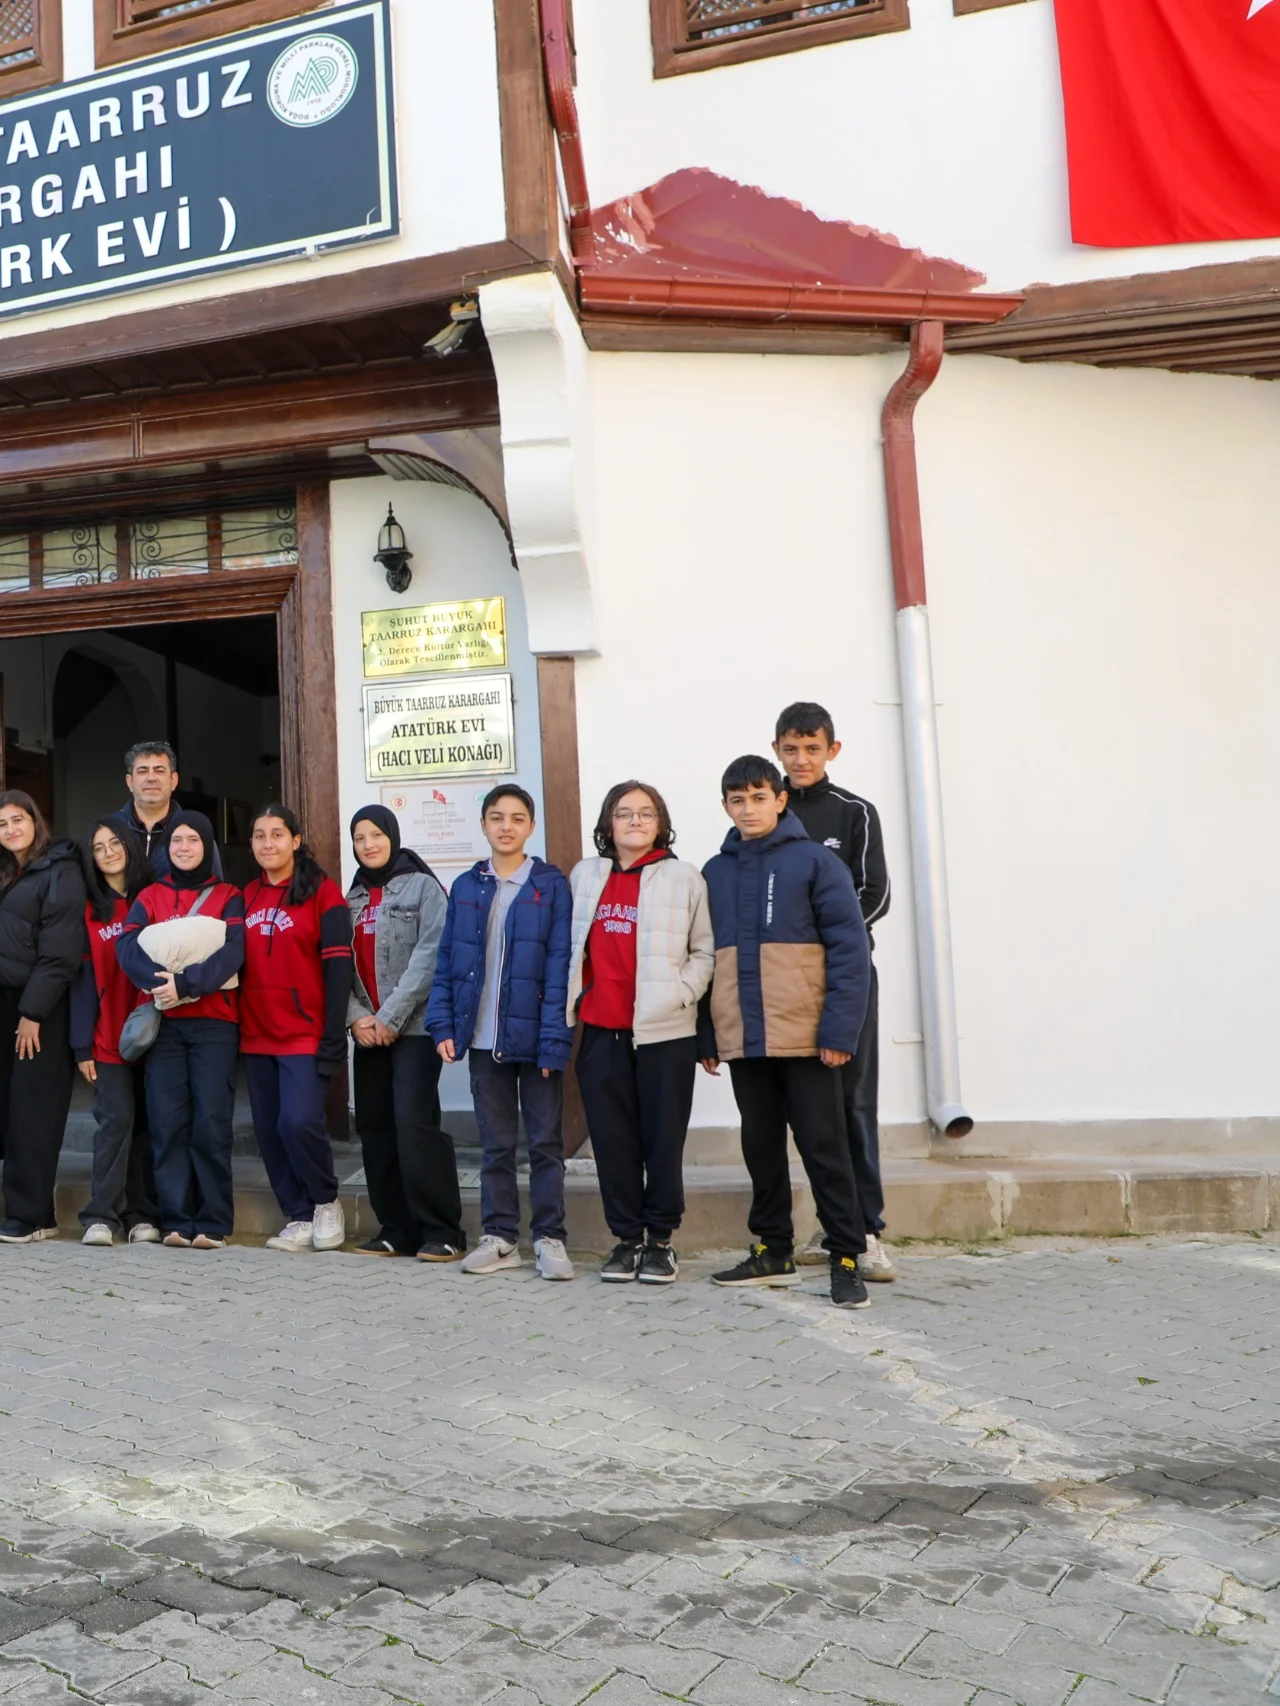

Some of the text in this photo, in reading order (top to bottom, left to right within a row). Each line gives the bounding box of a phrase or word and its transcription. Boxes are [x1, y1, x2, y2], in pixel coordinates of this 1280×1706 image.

[299, 41, 335, 51] PARKLAR
[335, 46, 351, 68] GENEL
[369, 621, 498, 642] TAARRUZ KARARGAHI
[389, 614, 429, 629] ŞUHUT
[389, 645, 421, 655] Derece
[380, 656, 411, 667] Olarak
[374, 691, 501, 714] BÜYÜK TAARRUZ KARARGAHI
[391, 713, 486, 739] ATATÜRK EVİ
[377, 738, 503, 772] (HACI VELİ KONAĞI)
